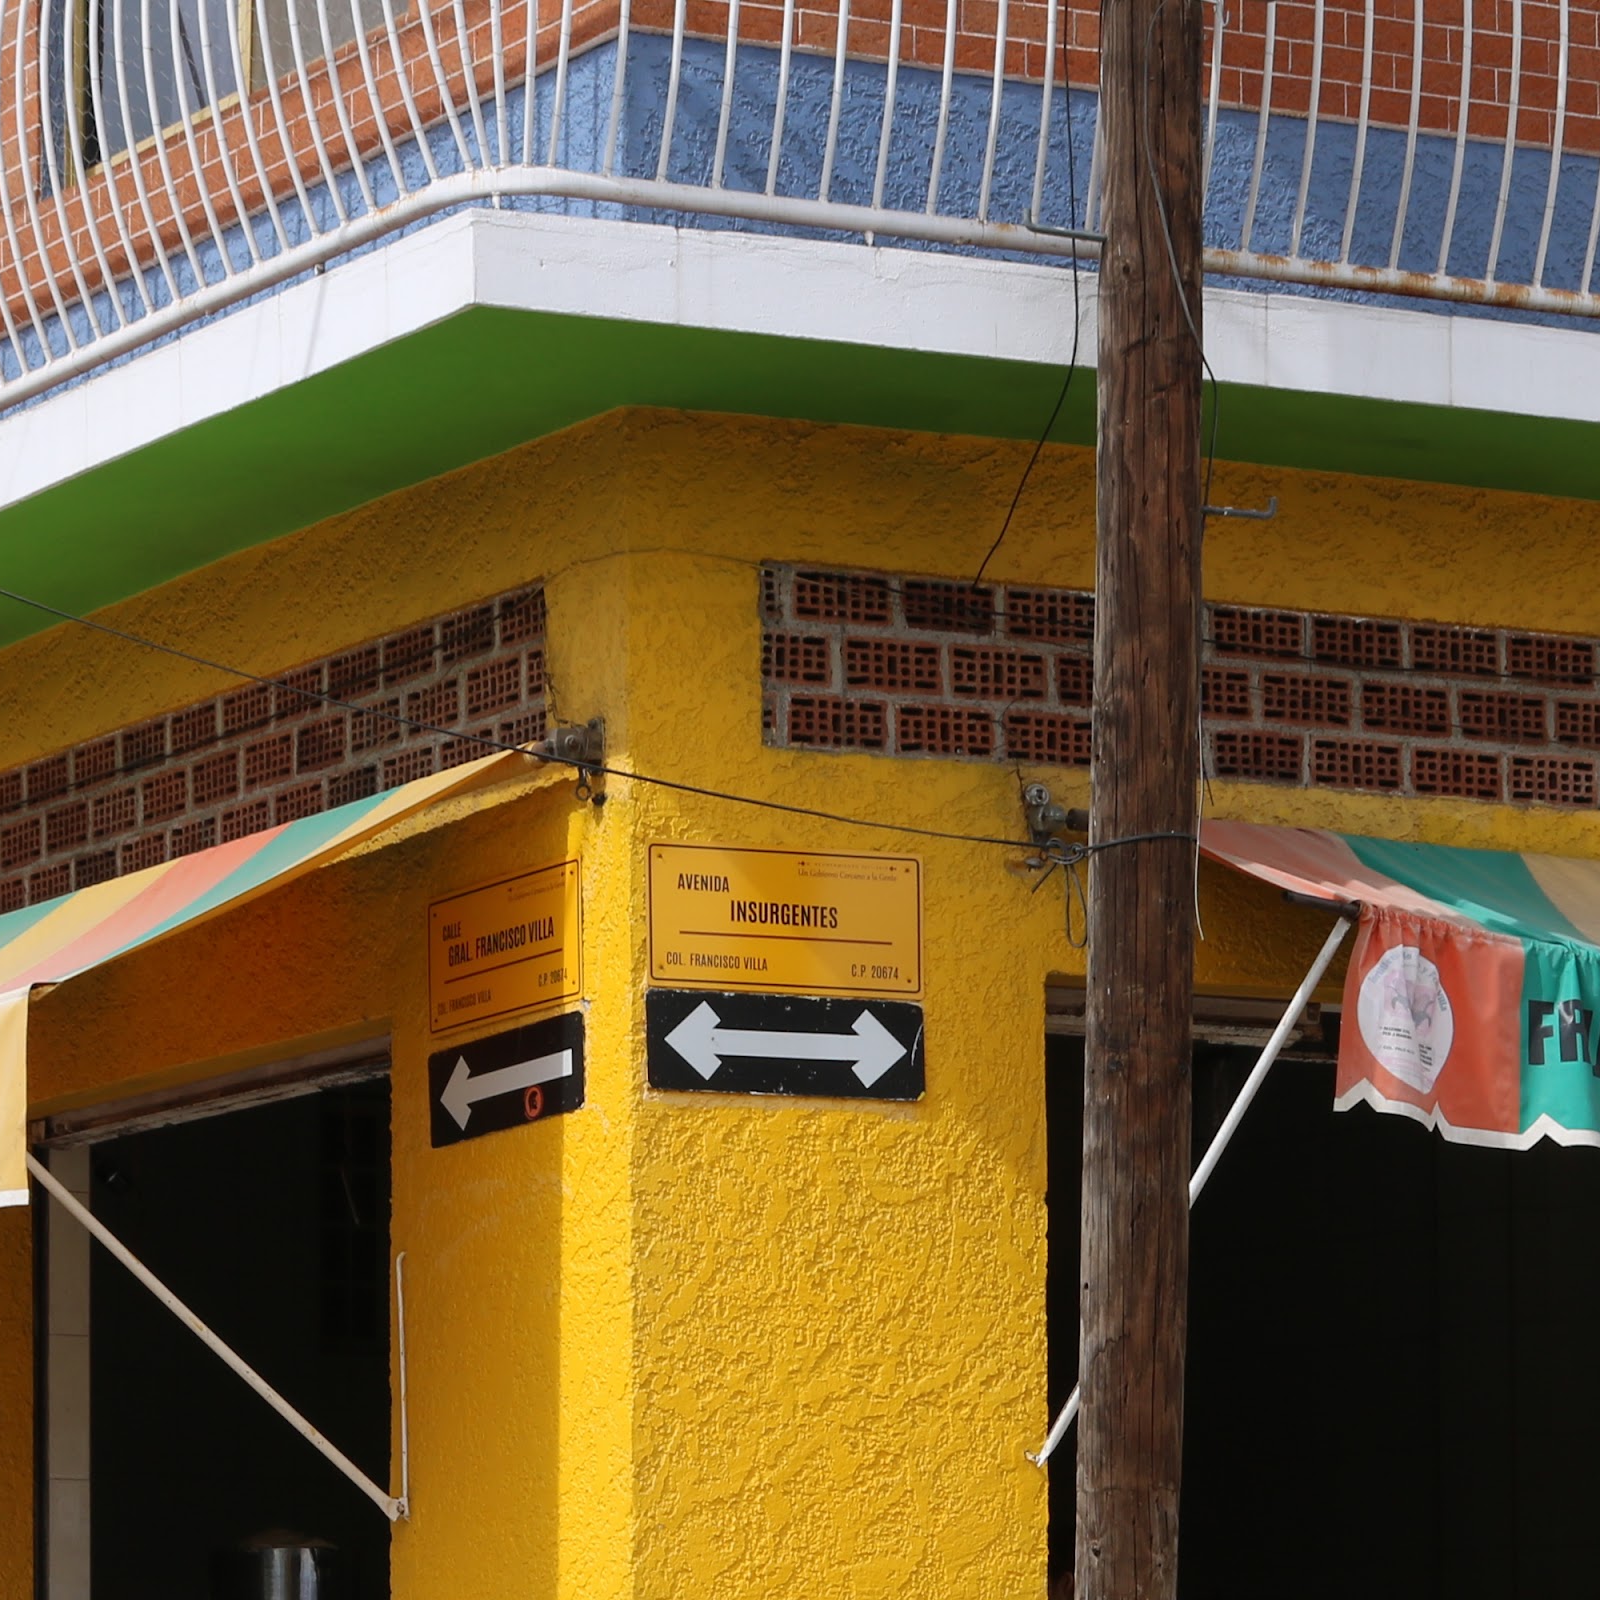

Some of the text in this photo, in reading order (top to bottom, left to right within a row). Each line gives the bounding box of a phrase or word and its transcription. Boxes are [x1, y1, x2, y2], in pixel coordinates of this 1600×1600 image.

[677, 872, 730, 893] AVENIDA
[730, 900, 838, 929] INSURGENTES
[442, 921, 462, 942] CALLE
[448, 915, 555, 967] GRAL. FRANCISCO VILLA
[666, 951, 768, 971] COL. FRANCISCO VILLA
[550, 967, 568, 985] 20674
[871, 965, 899, 981] 20674
[449, 993, 477, 1012] FRANCISCO
[477, 989, 492, 1004] VILLA
